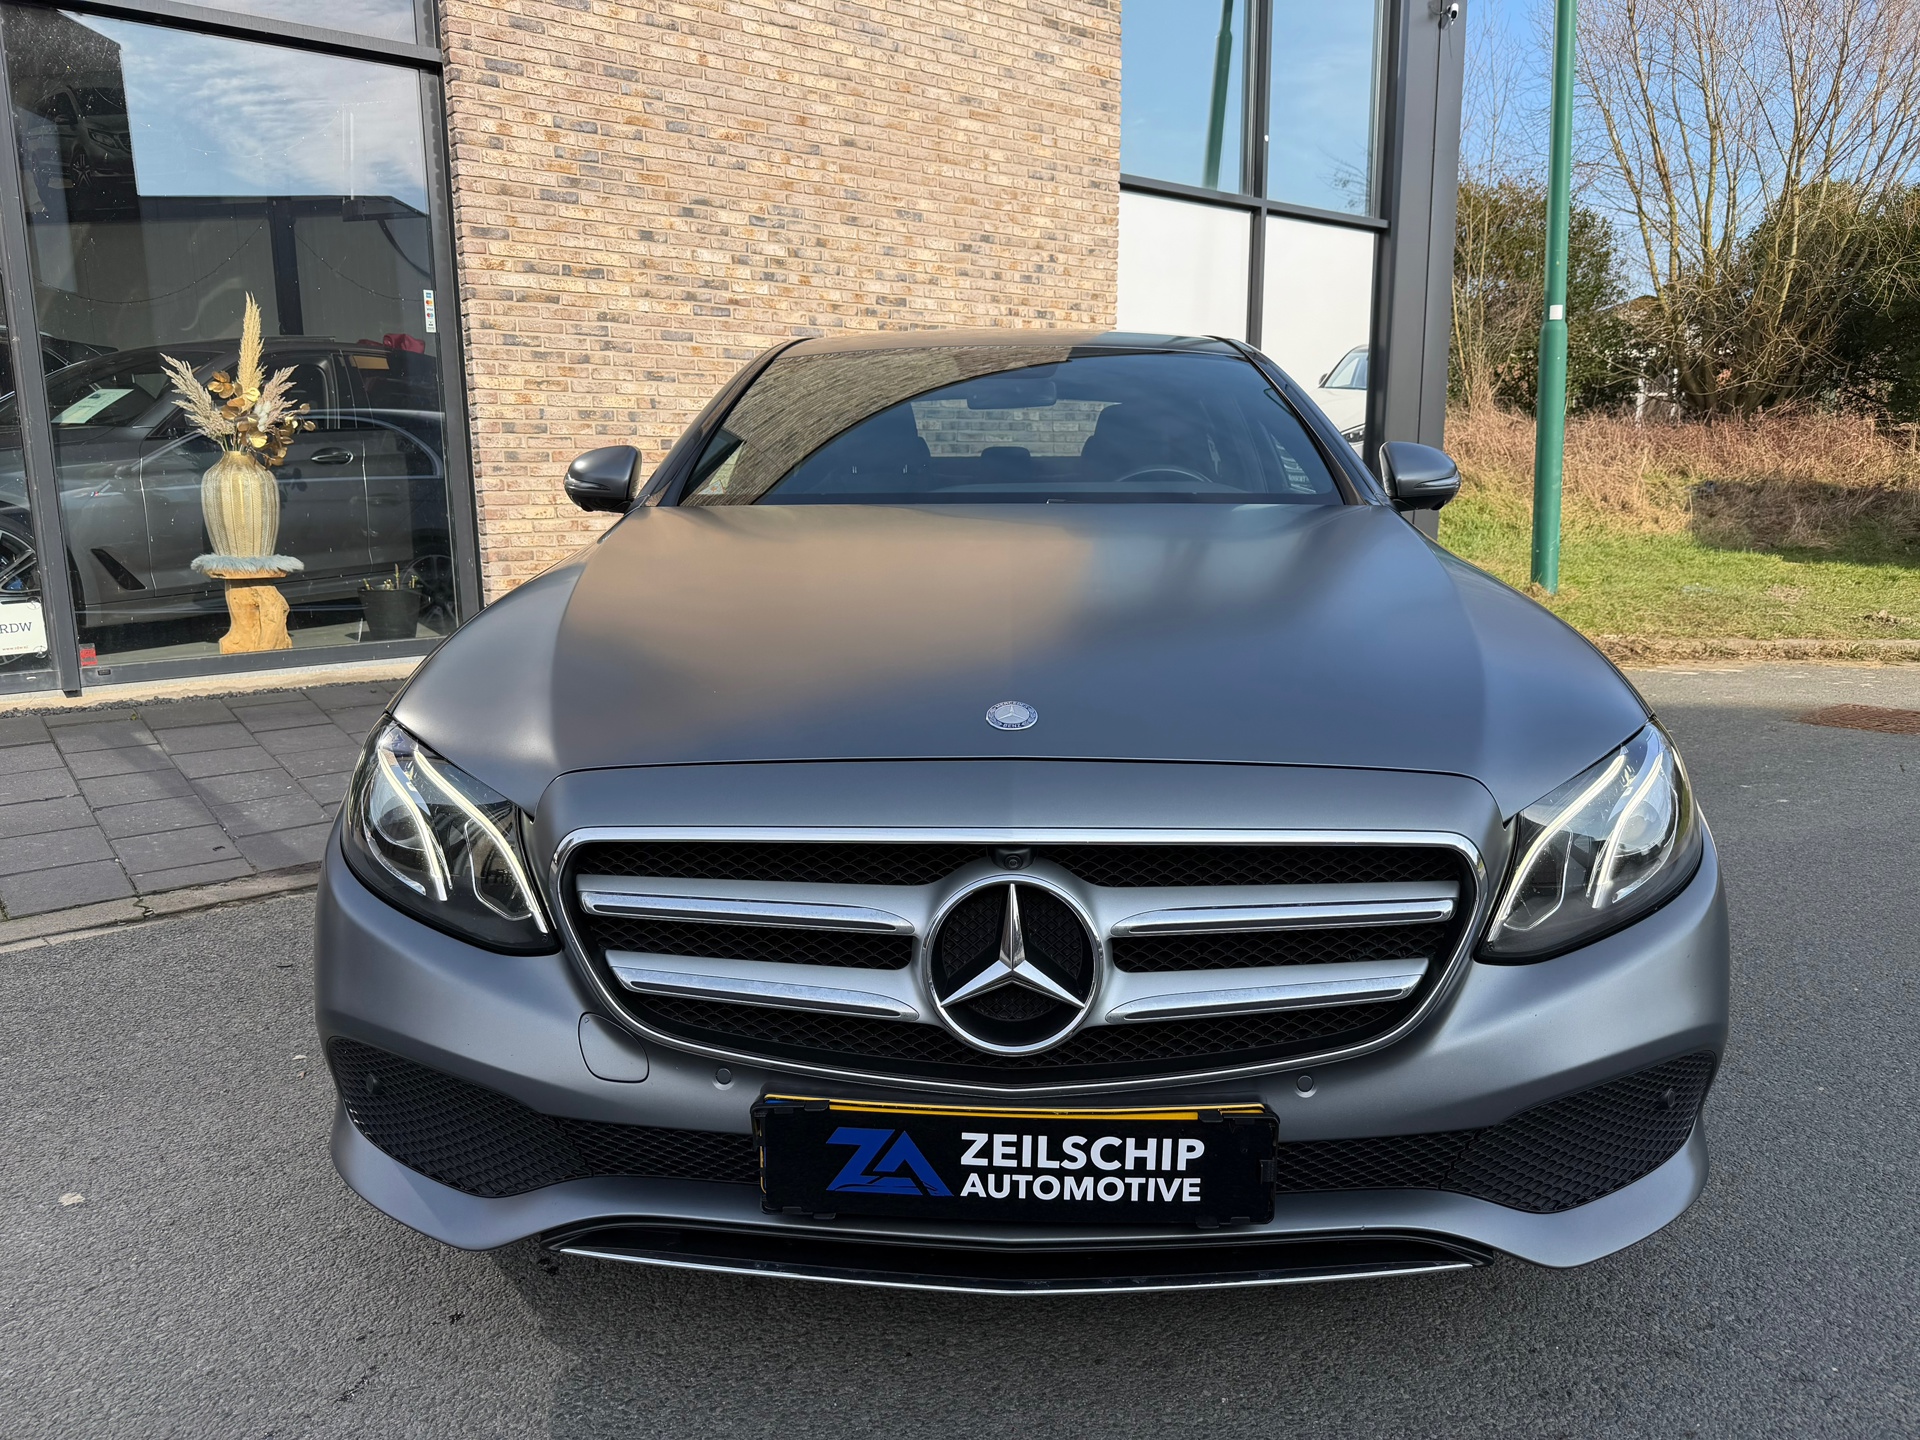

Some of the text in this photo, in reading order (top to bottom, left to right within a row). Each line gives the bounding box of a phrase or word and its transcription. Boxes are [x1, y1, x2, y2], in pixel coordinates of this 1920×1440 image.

[0, 621, 32, 634] RDW
[960, 1132, 1205, 1171] ZEILSCHIP
[960, 1173, 1201, 1202] AUTOMOTIVE
